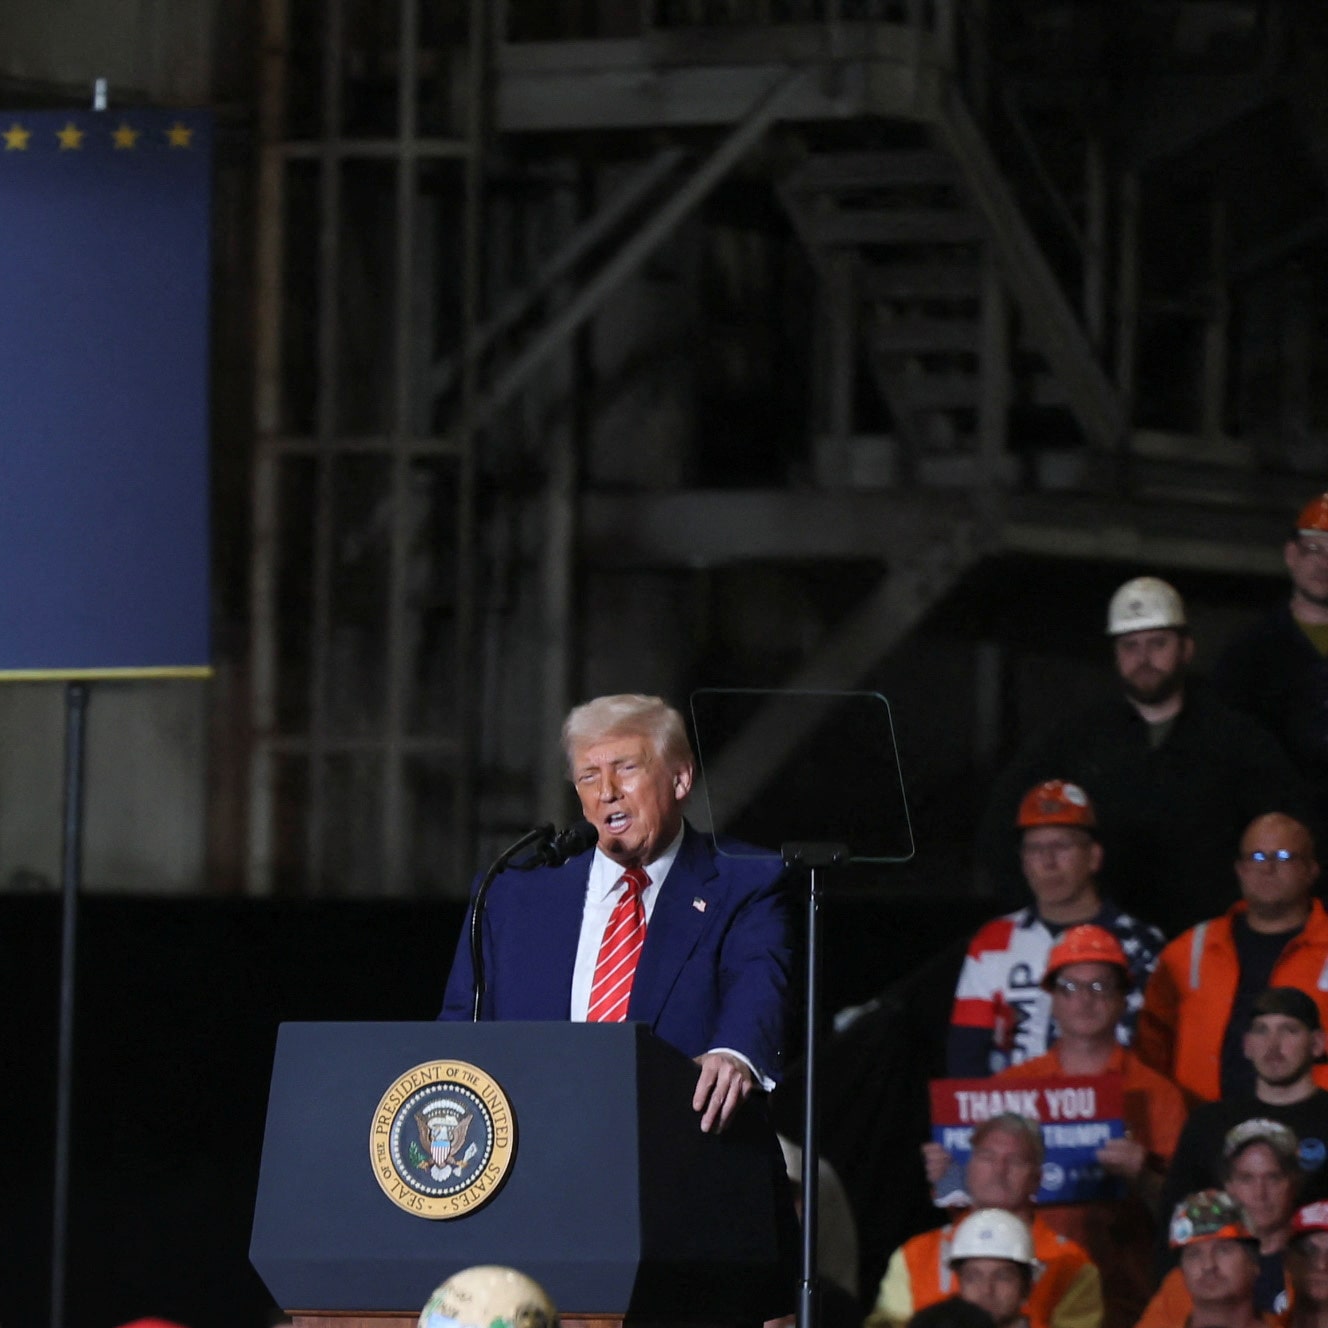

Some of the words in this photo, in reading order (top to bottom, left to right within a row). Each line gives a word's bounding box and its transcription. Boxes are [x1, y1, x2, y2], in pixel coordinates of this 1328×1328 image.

[446, 1068, 460, 1078] OF
[462, 1071, 479, 1086] THE
[375, 1066, 442, 1135] PRESIDENT
[1044, 1087, 1096, 1120] YOU
[481, 1084, 508, 1149] UNITED
[376, 1142, 386, 1163] THE
[381, 1164, 391, 1180] OF
[391, 1182, 425, 1211] SEAL
[452, 1164, 501, 1211] STATES
